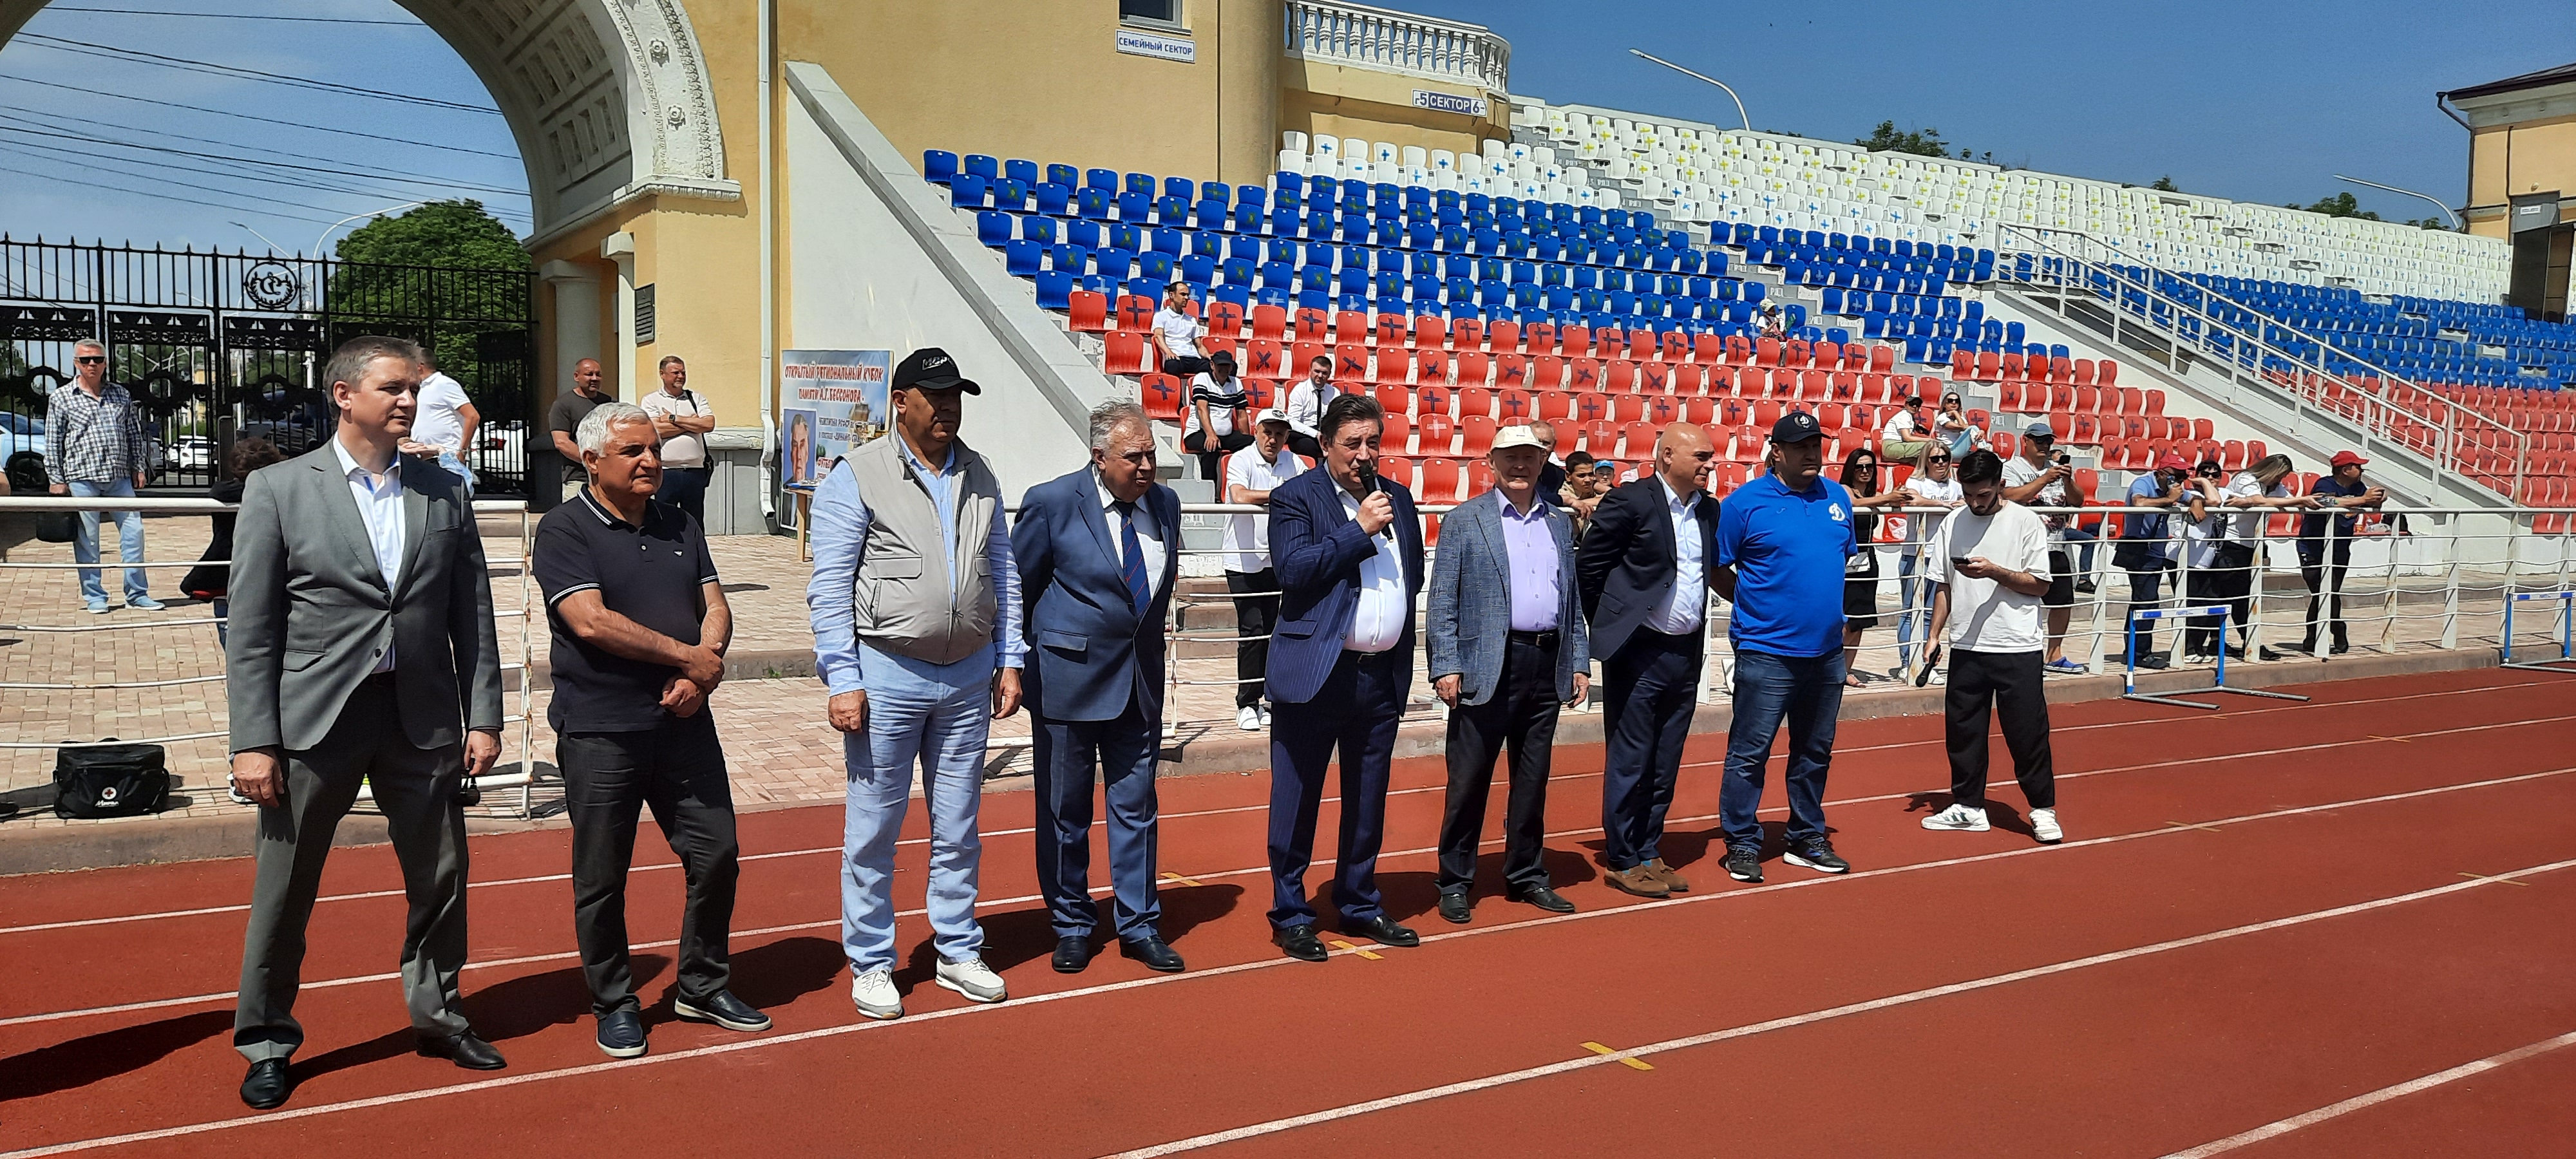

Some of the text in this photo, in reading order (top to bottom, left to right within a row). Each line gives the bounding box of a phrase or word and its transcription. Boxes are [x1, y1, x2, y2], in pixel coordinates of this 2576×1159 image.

[1119, 37, 1192, 55] СЕМЕЙНЫЙ СЕКТОР
[1419, 93, 1480, 114] 5 СЕКТОР 6
[863, 367, 884, 382] КУБОК
